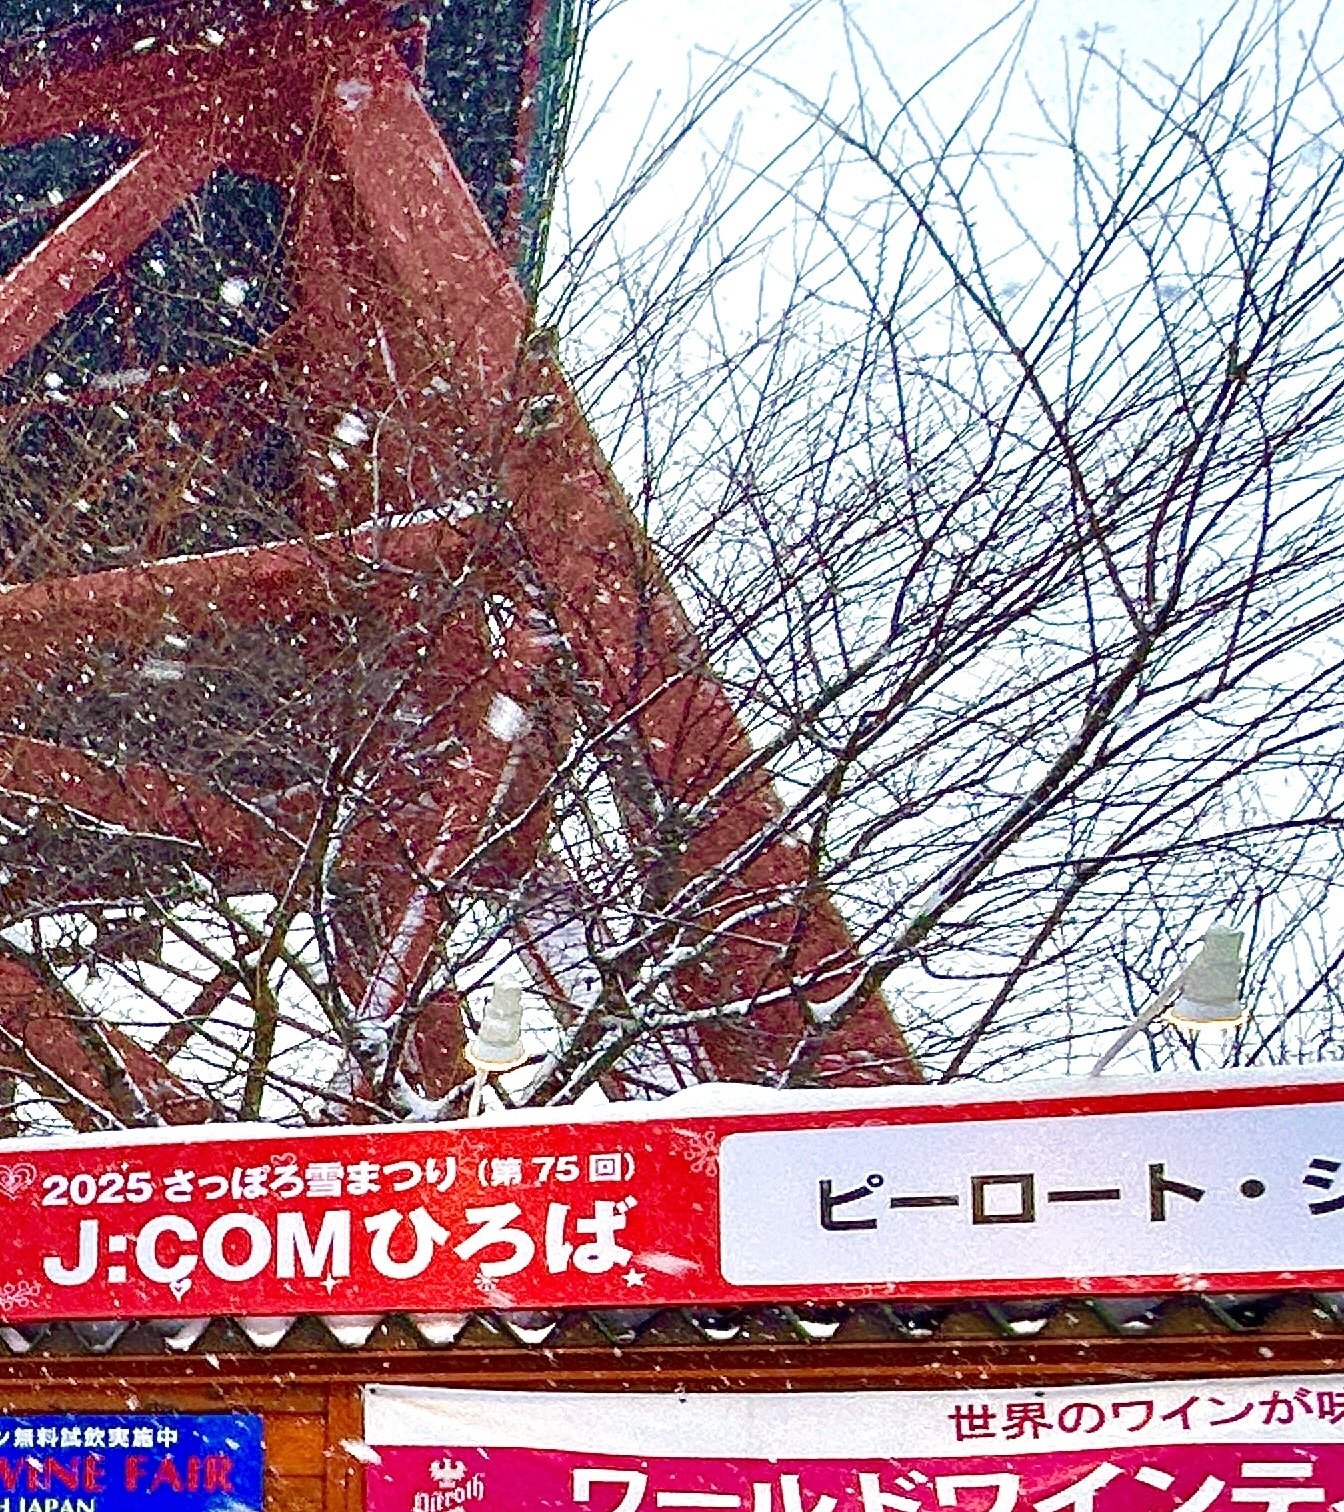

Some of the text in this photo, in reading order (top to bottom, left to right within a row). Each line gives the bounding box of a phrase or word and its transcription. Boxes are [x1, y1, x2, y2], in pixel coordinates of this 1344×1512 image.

[42, 1172, 154, 1207] 2025
[163, 1155, 457, 1205] さっぽろ雪まつり
[124, 1453, 235, 1493] FAIR
